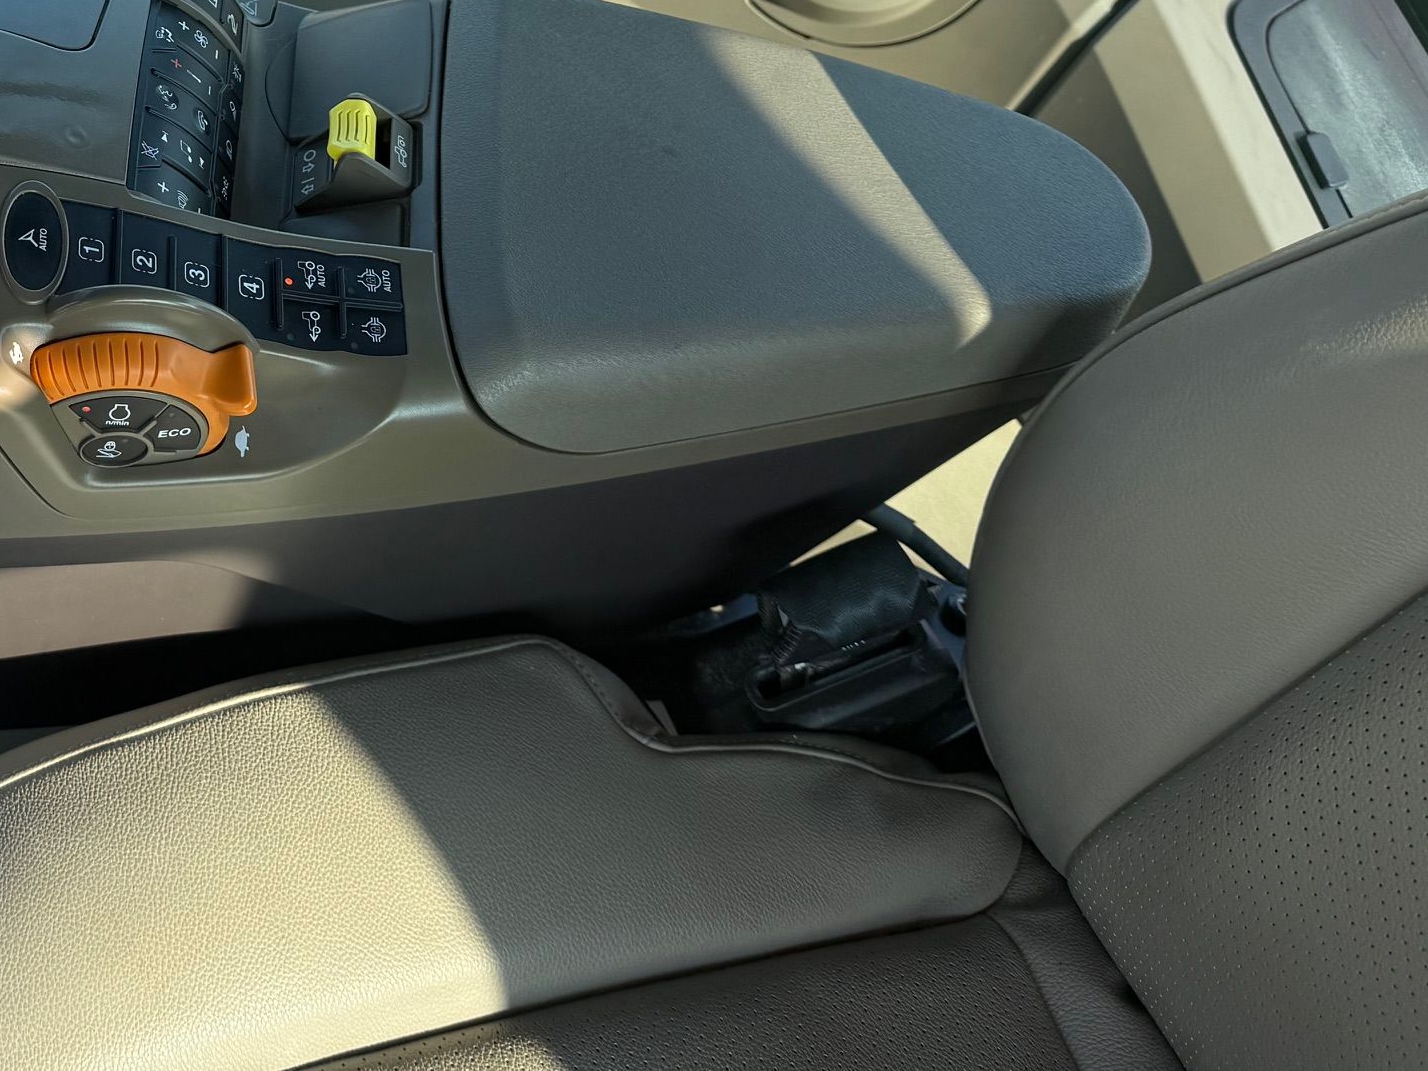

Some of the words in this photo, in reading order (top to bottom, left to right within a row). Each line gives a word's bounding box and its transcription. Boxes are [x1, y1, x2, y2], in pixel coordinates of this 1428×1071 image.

[38, 228, 48, 251] AUTO
[136, 255, 153, 268] 2
[189, 268, 205, 281] 3
[317, 264, 326, 288] AUTO
[381, 269, 392, 293] AUTO
[243, 280, 260, 294] 4
[158, 427, 192, 438] ECO
